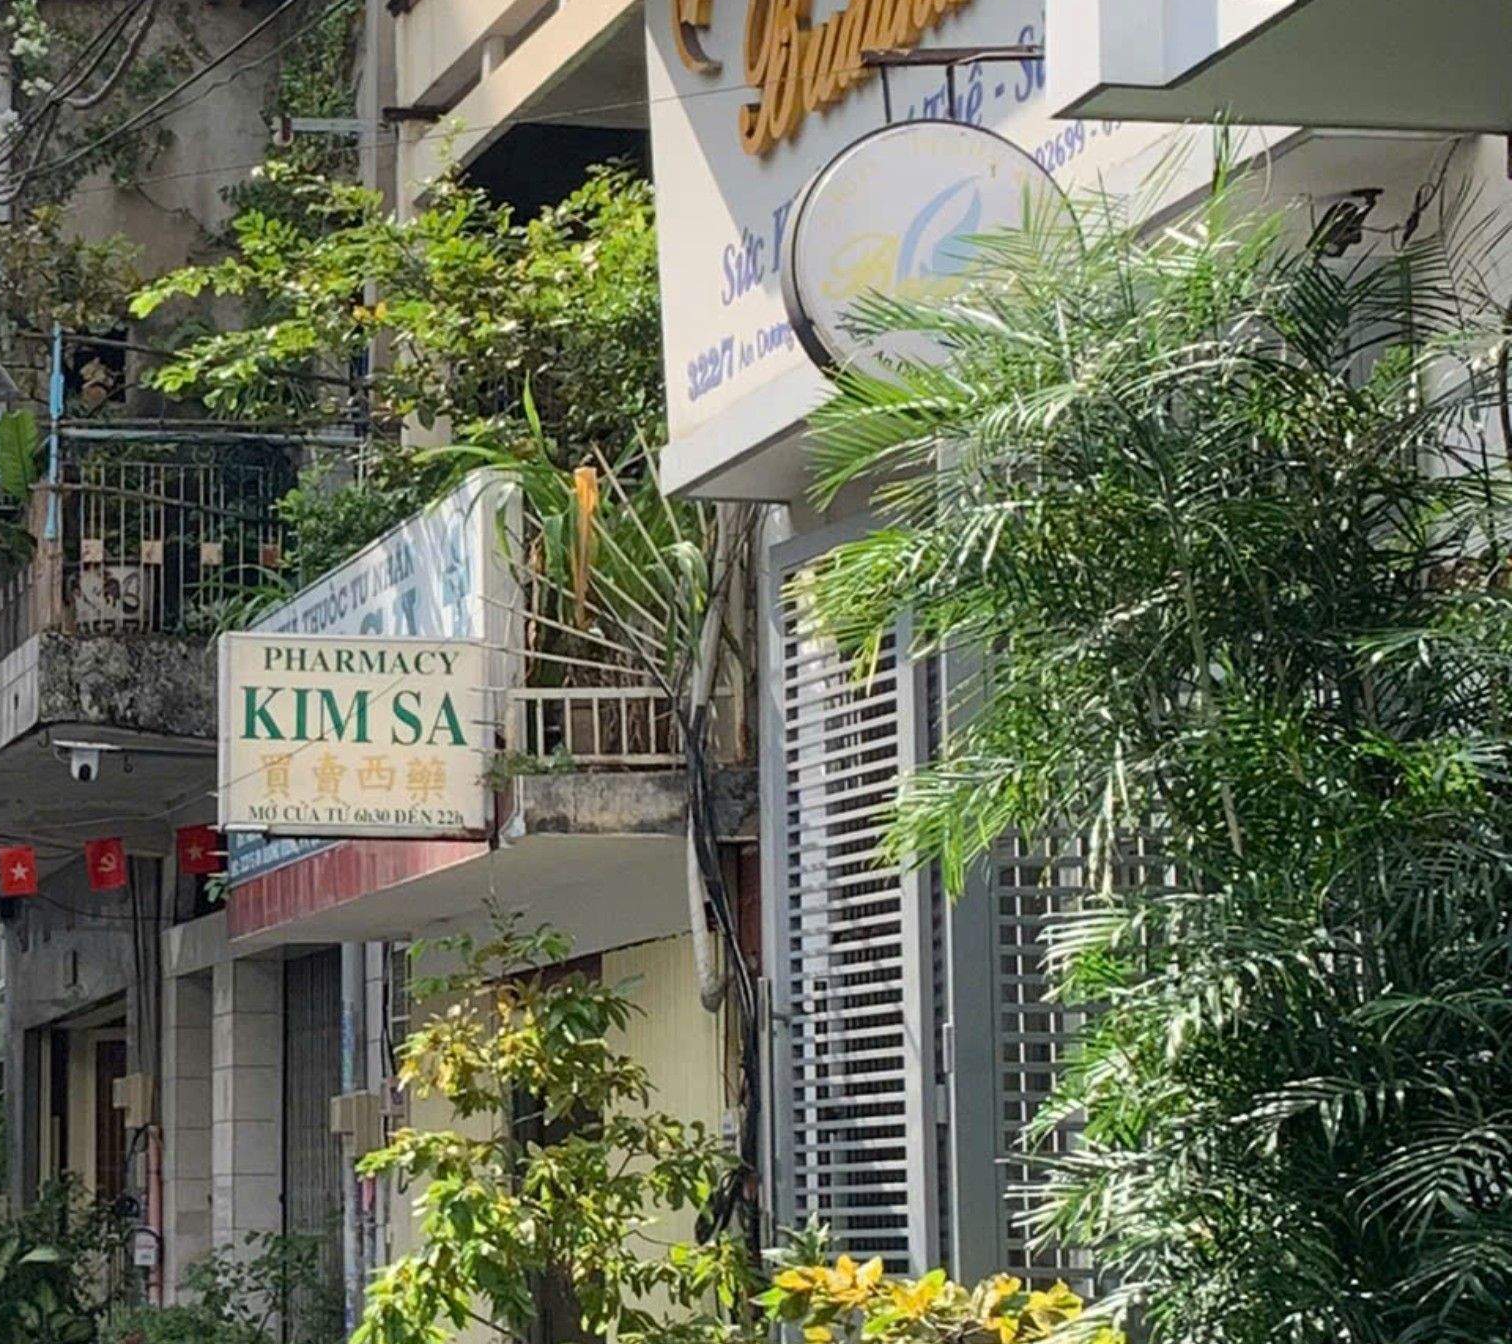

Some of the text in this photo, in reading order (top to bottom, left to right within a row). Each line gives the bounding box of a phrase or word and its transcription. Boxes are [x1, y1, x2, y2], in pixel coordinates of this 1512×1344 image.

[263, 645, 460, 676] PHARMACY
[239, 684, 469, 748] KIM SA
[249, 799, 278, 821] MỞ
[283, 799, 321, 822] CỬA
[354, 808, 390, 824] 6h30
[437, 809, 464, 826] 22h
